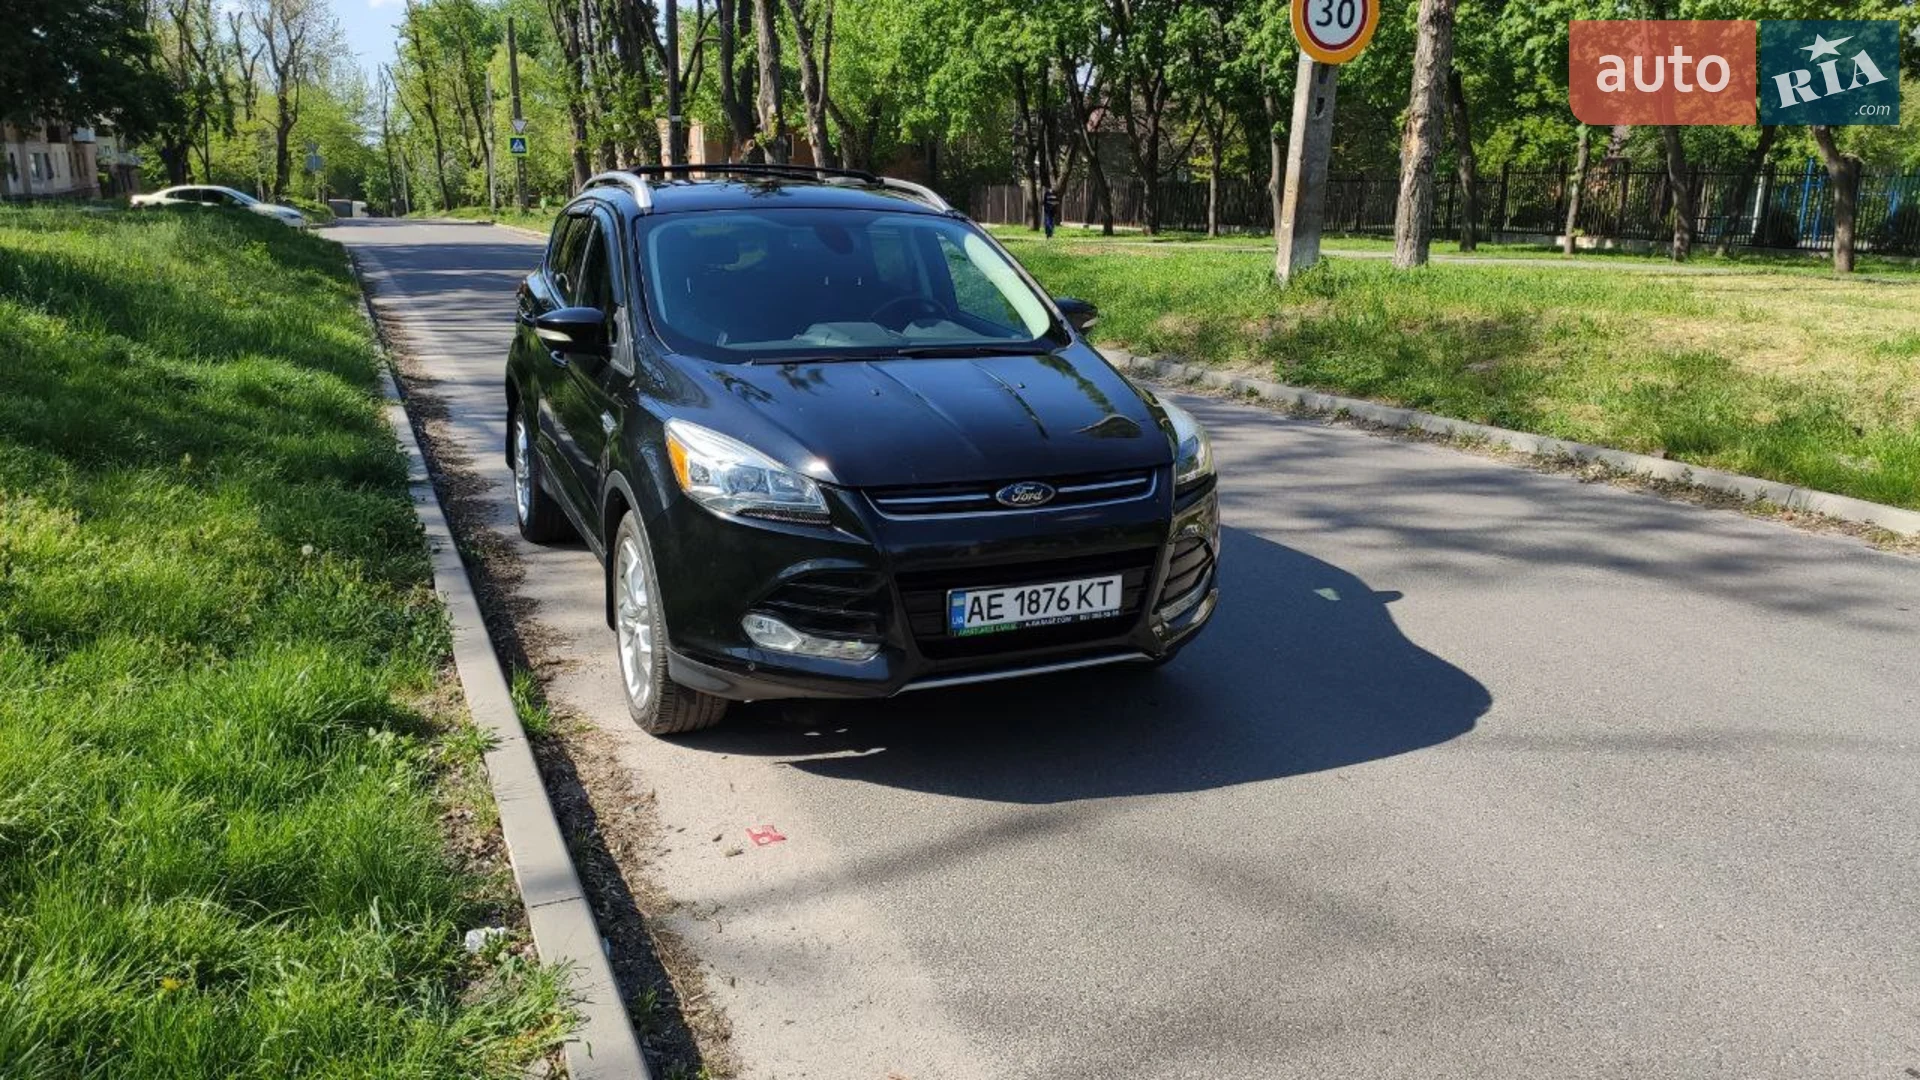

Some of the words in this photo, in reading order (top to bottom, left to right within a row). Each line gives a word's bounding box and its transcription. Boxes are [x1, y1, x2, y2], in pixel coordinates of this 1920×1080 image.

[1315, 0, 1355, 28] 30
[1011, 485, 1043, 502] Ford
[967, 593, 1005, 624] AE
[1013, 585, 1071, 616] 1876
[1076, 580, 1114, 610] KT
